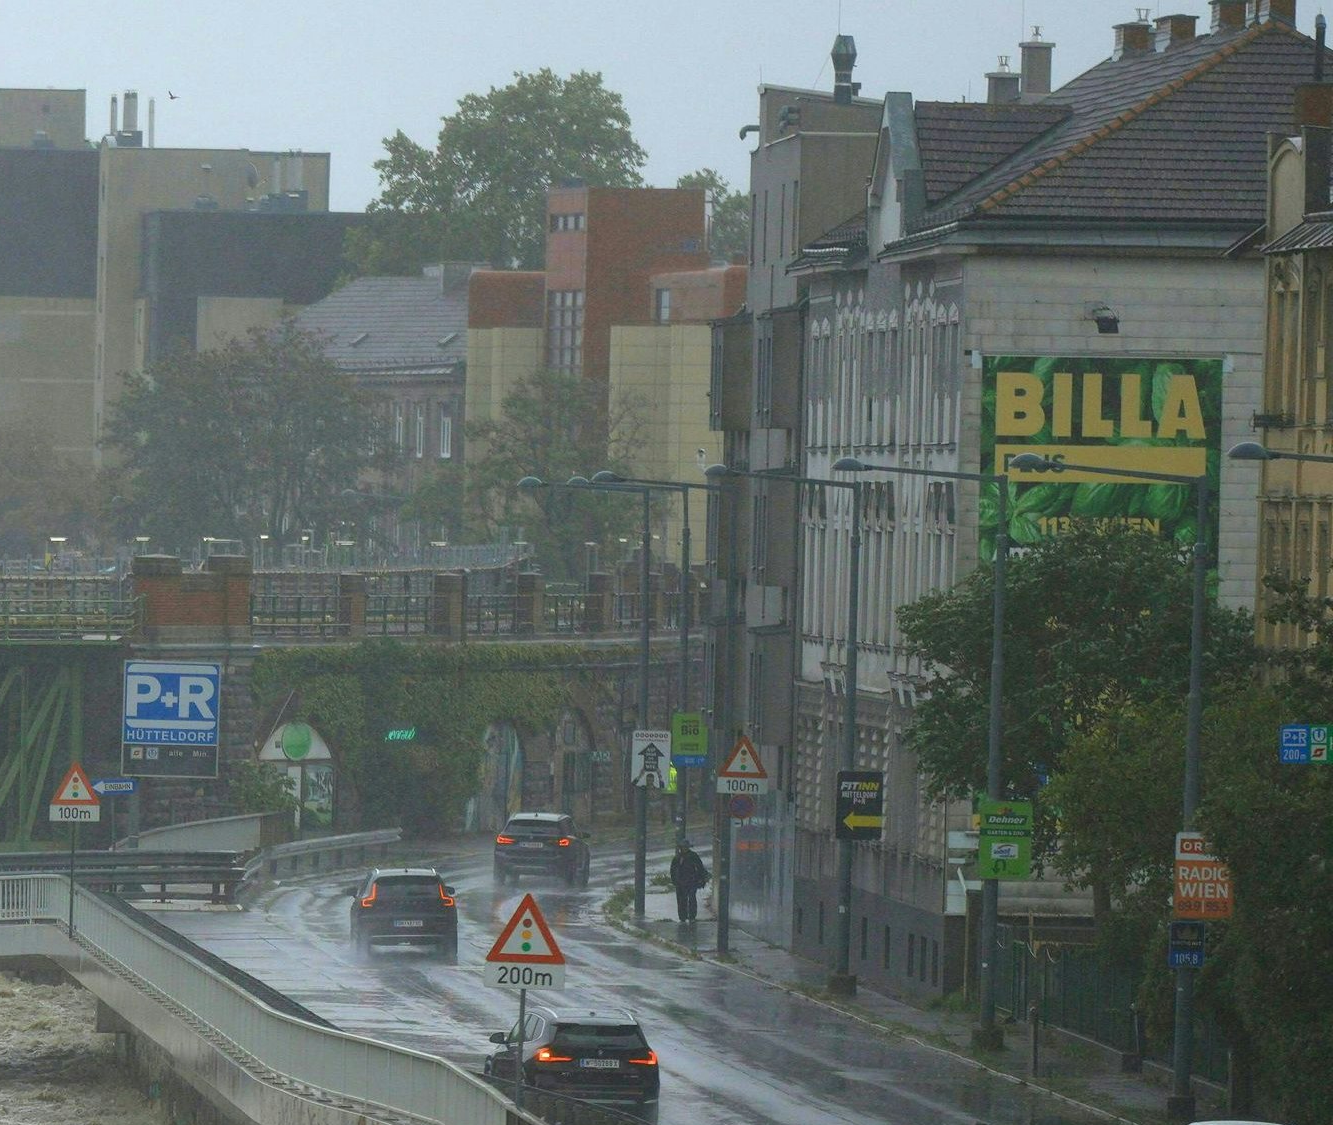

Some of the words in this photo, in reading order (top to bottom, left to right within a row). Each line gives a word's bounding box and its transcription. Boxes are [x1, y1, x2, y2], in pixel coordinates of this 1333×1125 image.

[995, 371, 1206, 440] BILLA
[126, 675, 215, 719] P+R
[126, 729, 214, 742] HÜTTELDORF
[1283, 731, 1307, 744] P+R
[104, 783, 132, 791] EINBAHN
[726, 778, 759, 793] 100m
[58, 807, 91, 820] 100m
[988, 815, 1025, 824] Dehner
[1178, 881, 1229, 899] WIEN
[1174, 953, 1198, 965] 105.8
[497, 967, 553, 987] 200m
